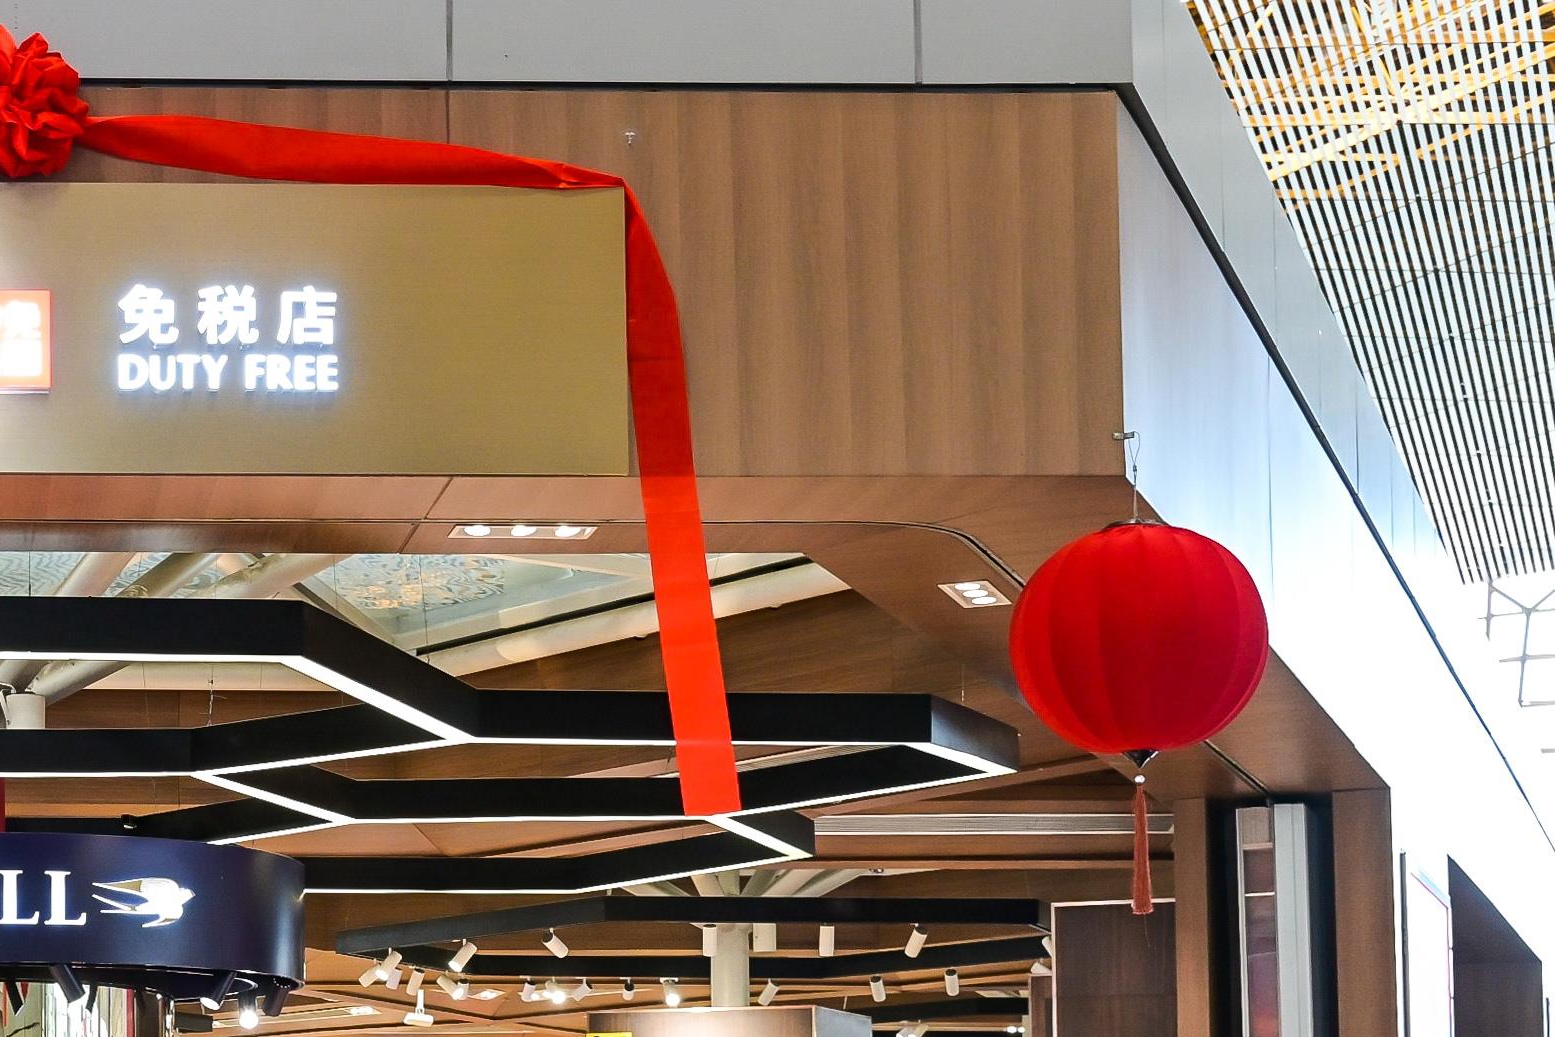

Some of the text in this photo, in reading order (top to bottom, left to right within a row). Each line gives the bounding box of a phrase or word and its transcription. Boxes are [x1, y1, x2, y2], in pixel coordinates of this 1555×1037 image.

[117, 283, 338, 346] 免税店
[117, 353, 339, 393] DUTY FREE
